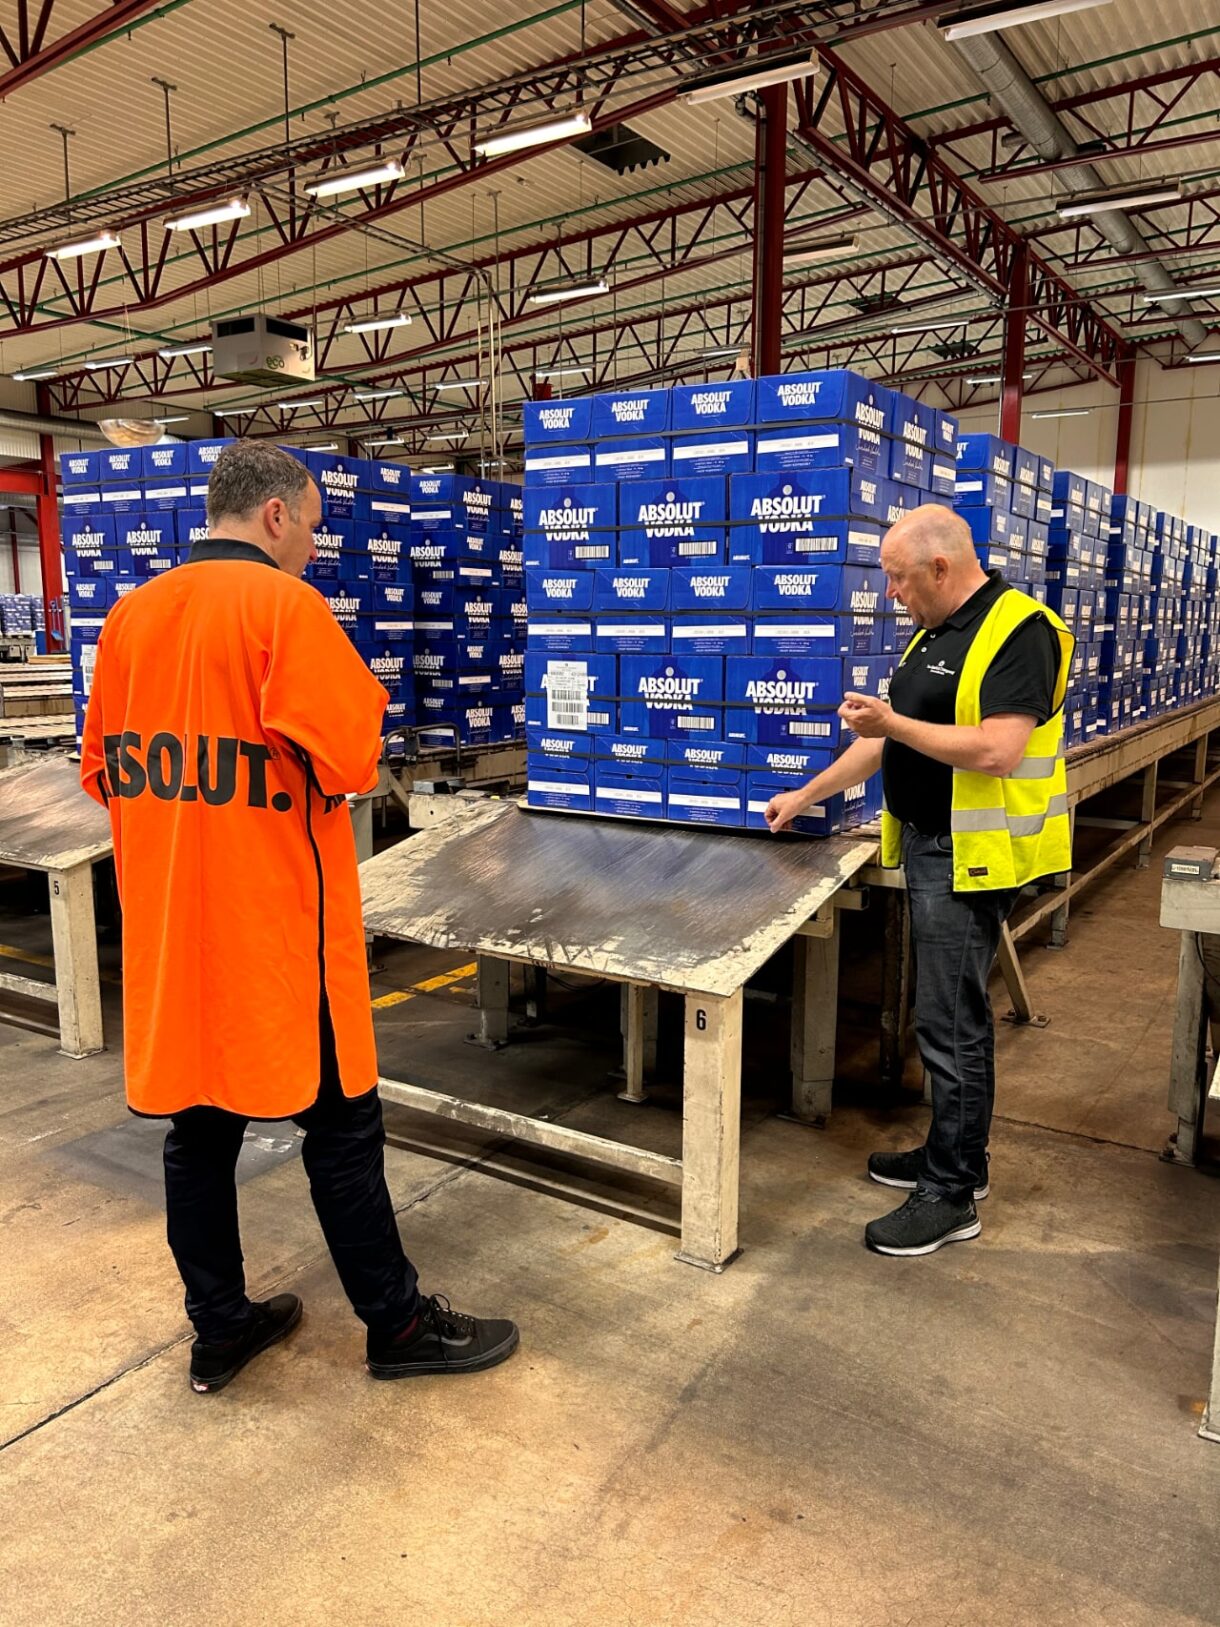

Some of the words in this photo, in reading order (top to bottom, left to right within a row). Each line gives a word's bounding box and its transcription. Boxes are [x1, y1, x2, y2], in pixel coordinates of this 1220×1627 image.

[777, 382, 822, 396] ABSOLUT
[691, 391, 732, 405] ABSOLUT
[782, 393, 815, 406] VODKA
[612, 399, 649, 413] ABSOLUT
[695, 402, 727, 415] VODKA
[539, 408, 574, 420] ABSOLUT
[615, 410, 645, 422] VODKA
[855, 401, 885, 429] ABSOLUT
[543, 418, 570, 429] VODKA
[903, 421, 927, 445] ABSOLUT
[109, 454, 130, 464] ABSOLUT
[152, 450, 174, 459] ABSOLUT
[321, 470, 358, 487] ABSOLUT
[463, 491, 492, 505] ABSOLUT
[638, 501, 702, 522] ABSOLUT
[751, 495, 822, 516] ABSOLUT
[539, 507, 595, 525] ABSOLUT
[644, 520, 694, 538] VODKA
[758, 514, 813, 533] VODKA
[72, 532, 104, 546] ABSOLUT
[127, 530, 161, 543] ABSOLUT
[544, 524, 589, 541] VODKA
[367, 538, 402, 552] ABSOLUT
[410, 546, 446, 557] ABSOLUT
[542, 579, 577, 589] ABSOLUT
[612, 578, 650, 589] ABSOLUT
[690, 576, 731, 587] ABSOLUT
[774, 574, 818, 586] ABSOLUT
[546, 587, 573, 598] VODKA
[616, 587, 645, 598] VODKA
[694, 585, 725, 597] VODKA
[779, 584, 812, 595] VODKA
[851, 591, 879, 609] ABSOLUT
[464, 602, 493, 614] ABSOLUT
[370, 658, 404, 669] ABSOLUT
[638, 677, 700, 695] ABSOLUT
[745, 680, 816, 699] ABSOLUT
[644, 692, 692, 710] VODKA
[752, 697, 807, 716] VODKA
[541, 738, 574, 750] ABSOLUT
[612, 744, 648, 756] ABSOLUT
[685, 748, 724, 762] ABSOLUT
[767, 753, 810, 766] ABSOLUT
[54, 881, 60, 895] 5
[696, 1008, 707, 1031] 6
